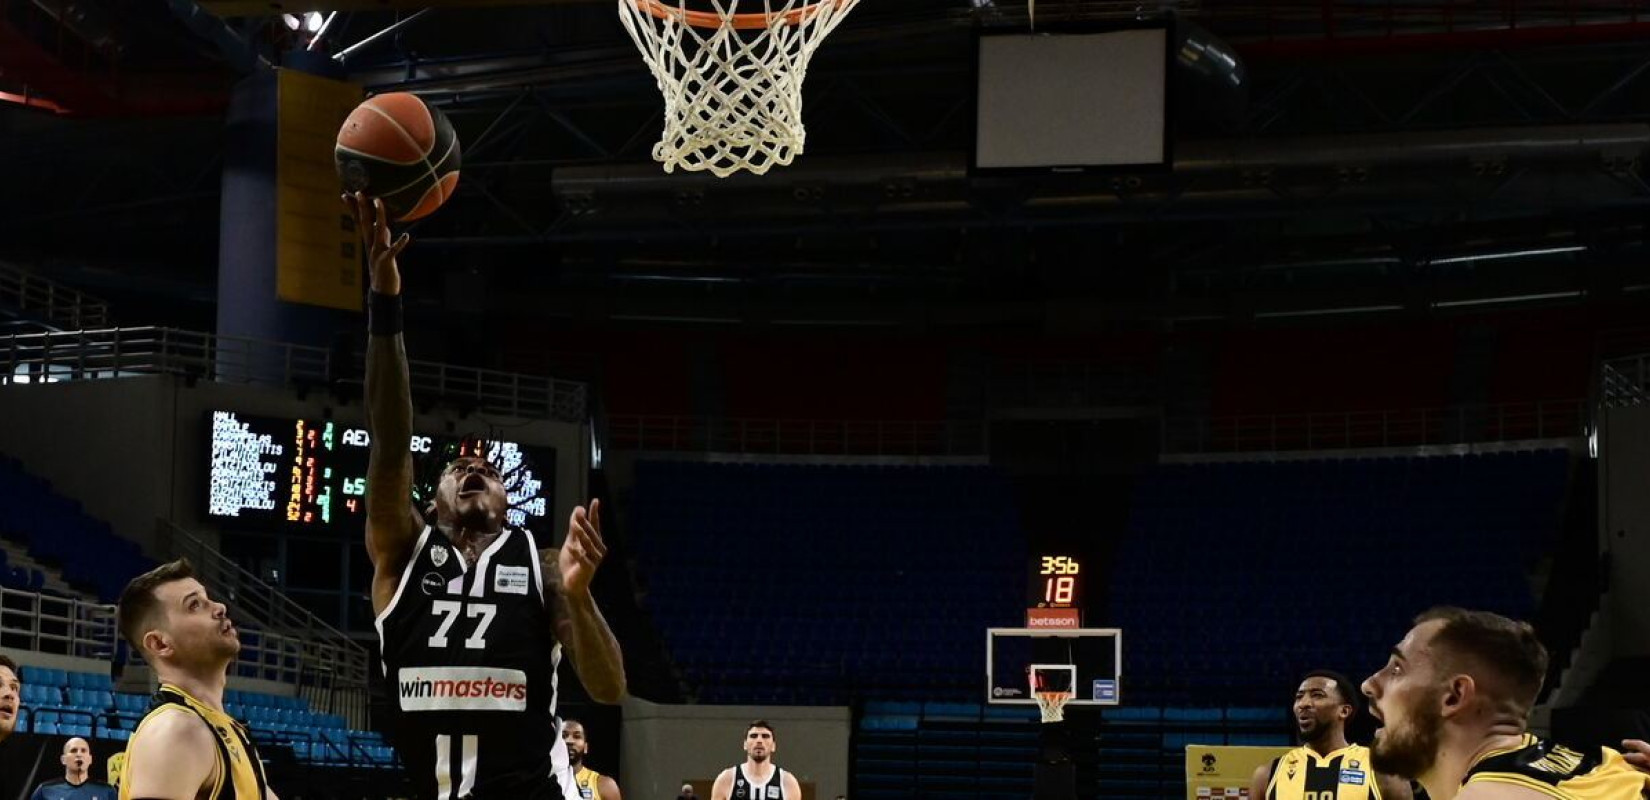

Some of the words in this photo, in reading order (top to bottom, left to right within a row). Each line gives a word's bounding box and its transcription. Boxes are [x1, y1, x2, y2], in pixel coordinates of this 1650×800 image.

[409, 435, 432, 453] BC
[346, 499, 356, 512] 4
[1040, 556, 1079, 575] 3:56
[1045, 577, 1074, 603] 18
[428, 599, 497, 649] 77
[1029, 617, 1076, 626] betsson
[400, 675, 527, 700] winmasters
